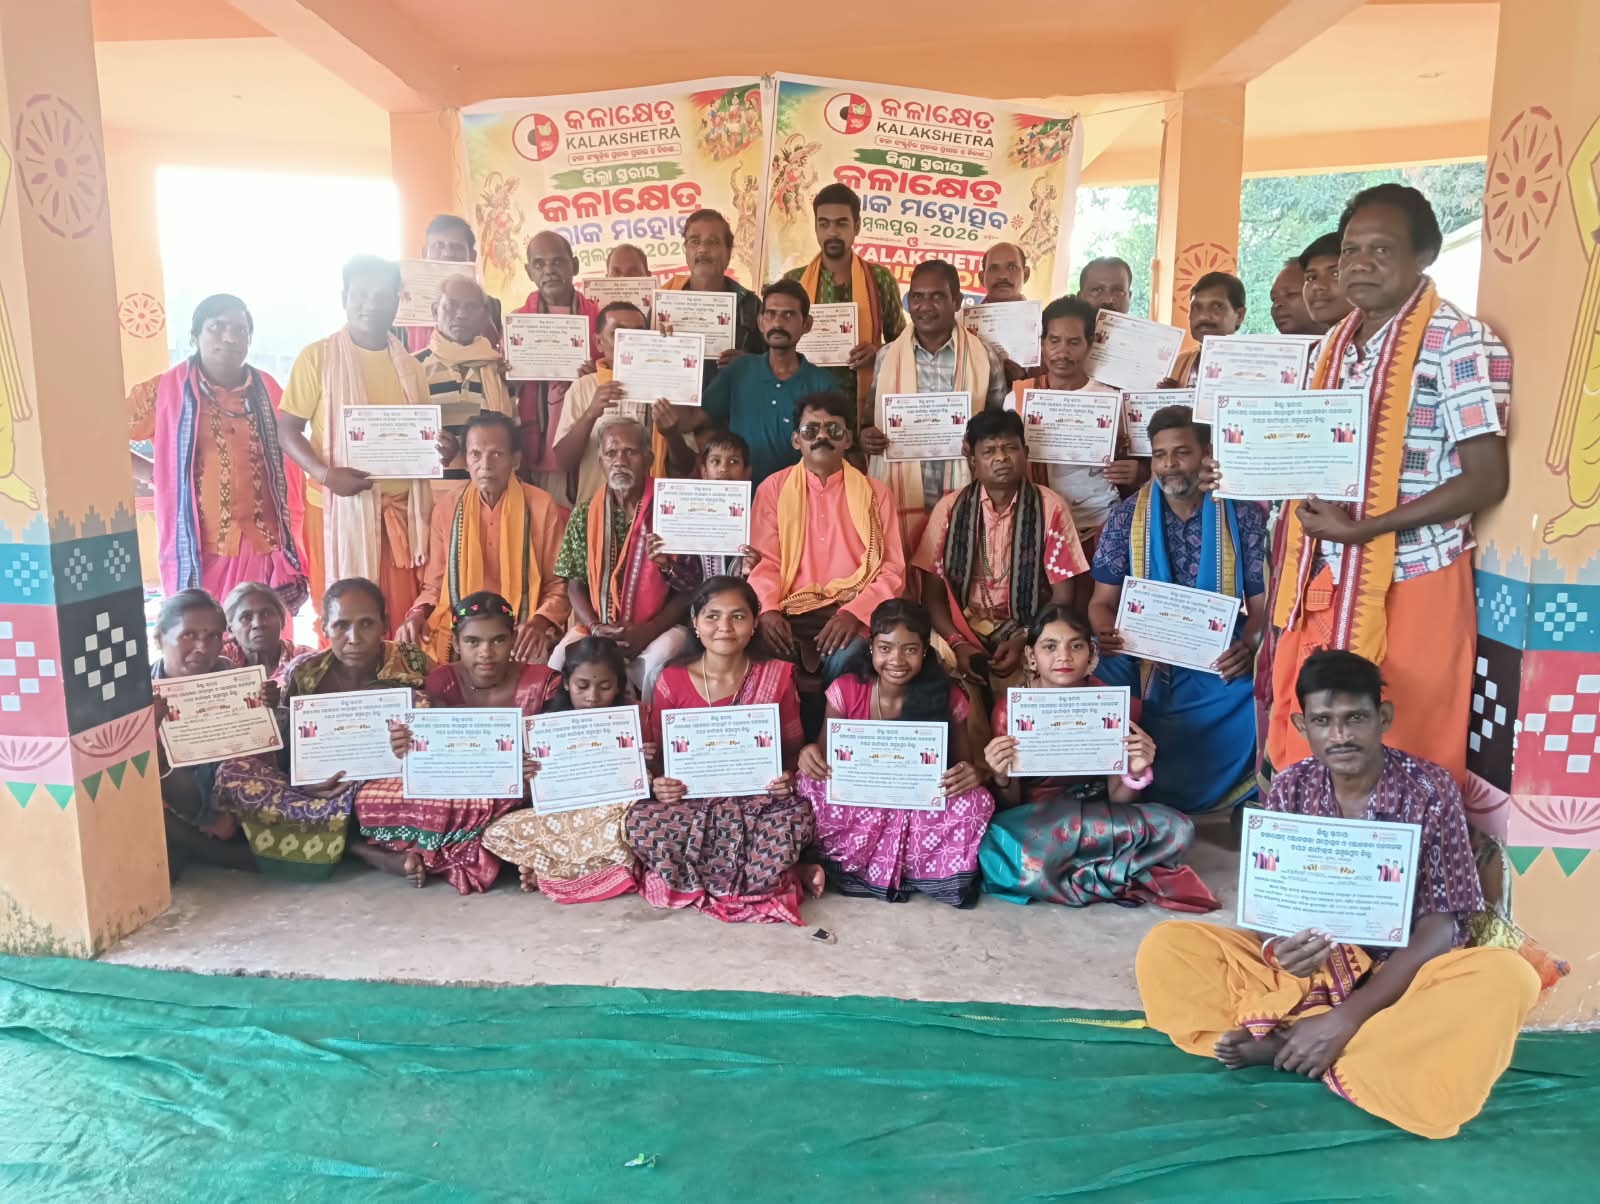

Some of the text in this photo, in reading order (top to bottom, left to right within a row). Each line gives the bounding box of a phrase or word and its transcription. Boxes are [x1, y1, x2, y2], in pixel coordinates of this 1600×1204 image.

[564, 100, 675, 130] କଳାକ୍ଷେତ୍ର
[881, 98, 995, 135] କଳାକ୍ଷେତ୍ର
[566, 126, 681, 150] KALAKSHETRA
[876, 121, 995, 148] KALAKSHETRA
[886, 151, 916, 169] ଜିଲ୍ଲା
[583, 167, 613, 186] ଜିଲ୍ଲା
[833, 165, 1002, 209] କଳାକ୍ଷେତ୍ର
[538, 181, 702, 222] କଳାକ୍ଷେତ୍ର
[862, 216, 918, 236] ମ୍ବଲପୁର
